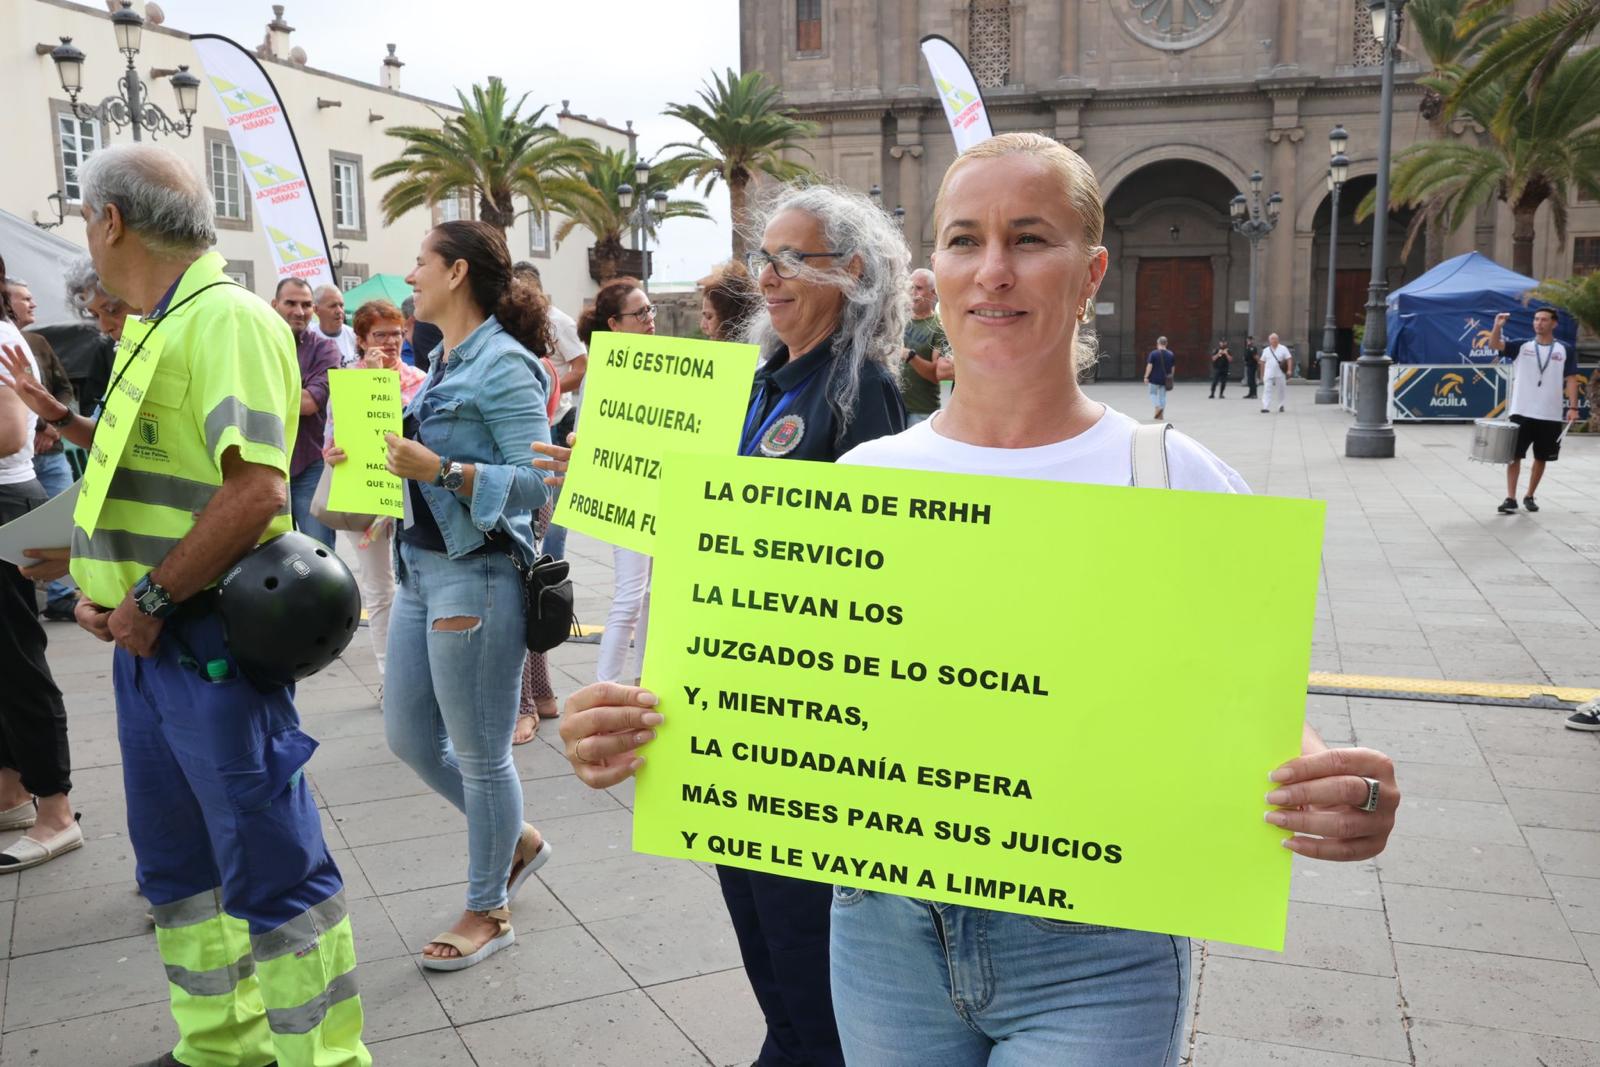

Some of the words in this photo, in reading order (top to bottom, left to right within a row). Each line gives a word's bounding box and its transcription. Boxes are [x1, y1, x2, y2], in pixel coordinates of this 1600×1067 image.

[607, 346, 629, 368] ASÍ
[633, 351, 714, 379] GESTIONA
[600, 399, 702, 434] CUALQUIERA:
[366, 480, 384, 488] QUE
[593, 448, 662, 480] PRIVATIZ
[569, 493, 636, 529] PROBLEMA
[704, 481, 734, 502] LA
[742, 484, 853, 513] OFICINA
[861, 494, 898, 517] DE
[909, 498, 991, 525] RRHH
[698, 532, 745, 556] DEL
[753, 538, 885, 570] SERVICIO
[692, 583, 723, 606] LA
[731, 588, 838, 619] LLEVAN
[849, 601, 903, 626] LOS
[686, 636, 834, 672] JUZGADOS
[843, 654, 880, 677] DE
[890, 659, 928, 682] LO
[937, 665, 1049, 697] SOCIAL
[683, 685, 708, 711] Y,
[718, 690, 868, 732] MIENTRAS,
[690, 735, 723, 758] LA
[731, 742, 907, 783] CIUDADANÍA
[917, 766, 1033, 800] ESPERA
[682, 783, 738, 809] MÁS
[747, 793, 839, 824] MESES
[847, 807, 924, 837] PARA
[934, 820, 991, 846] SUS
[1001, 831, 1123, 864] JUICIOS
[681, 830, 699, 850] Y
[707, 835, 762, 861] QUE
[771, 845, 803, 868] LE
[811, 851, 908, 885] VAYAN
[916, 869, 936, 890] A
[946, 873, 1074, 910] LIMPIAR.
